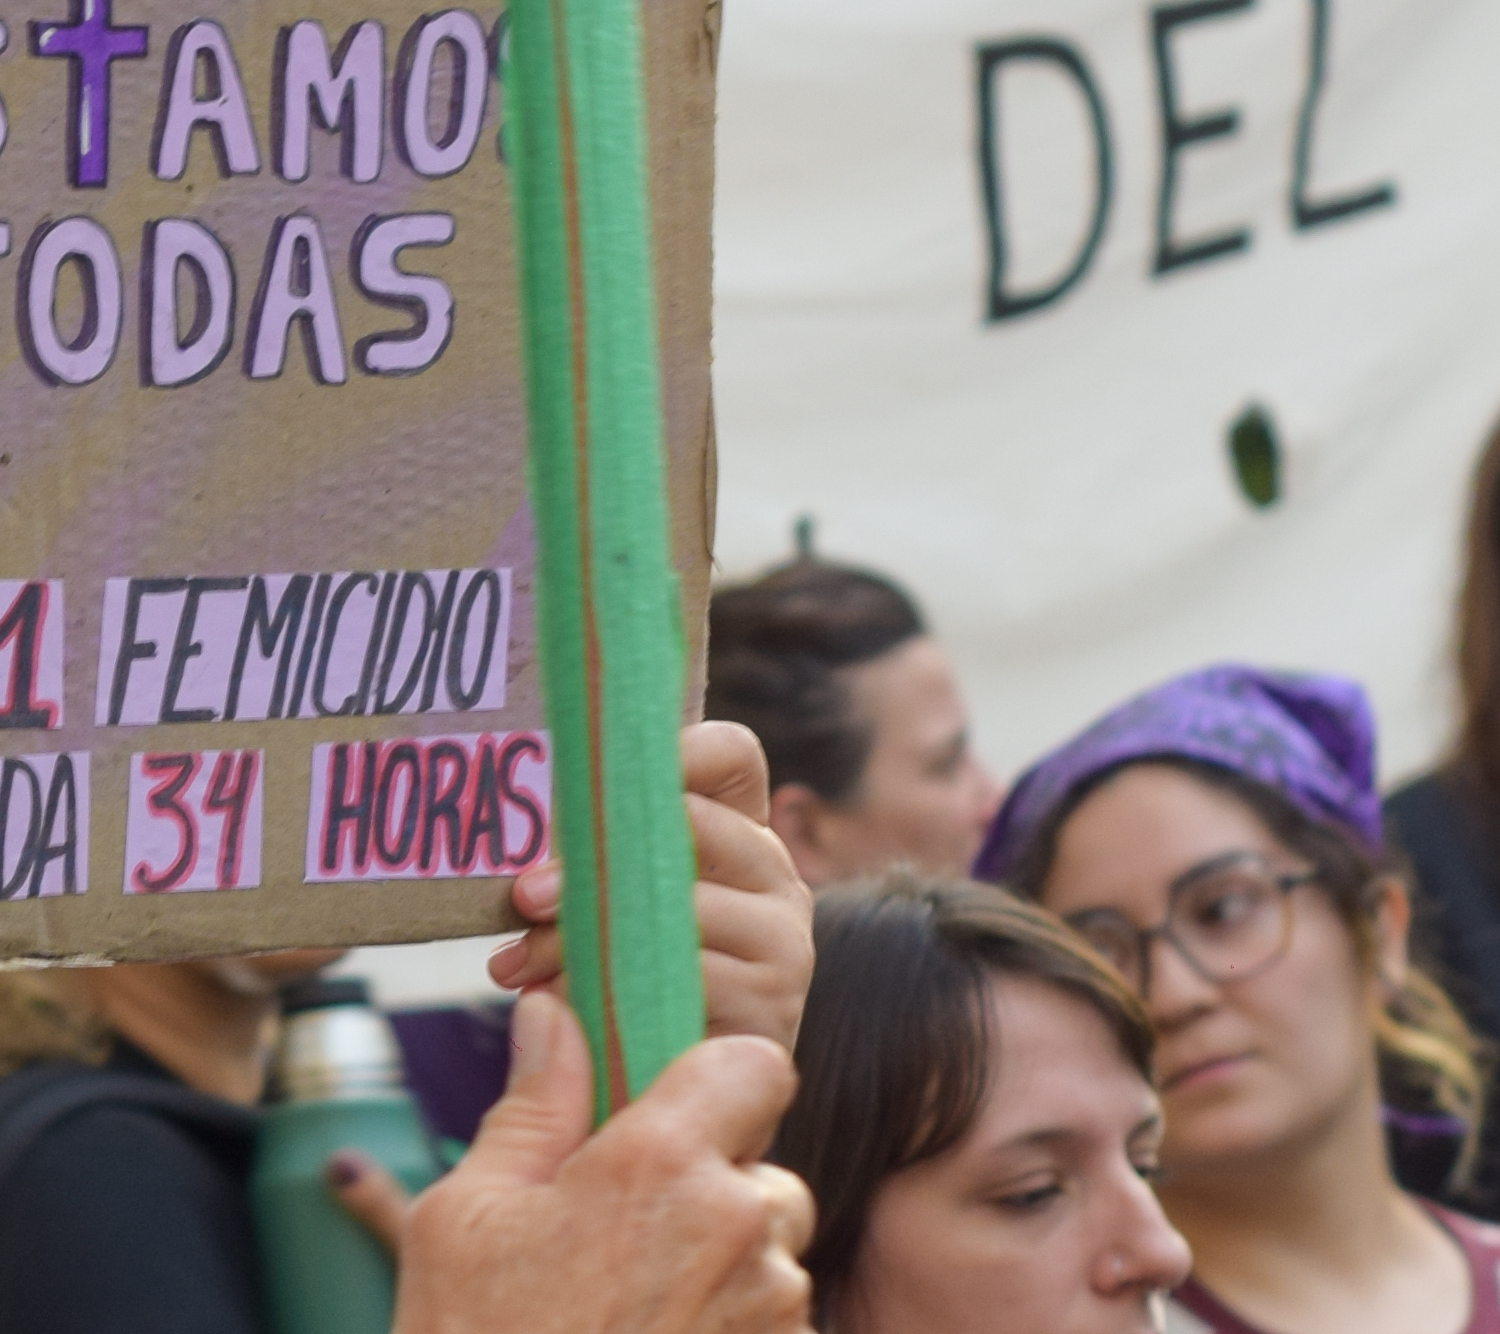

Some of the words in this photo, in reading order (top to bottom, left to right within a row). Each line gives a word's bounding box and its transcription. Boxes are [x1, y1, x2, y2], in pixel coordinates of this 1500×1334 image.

[108, 571, 501, 723] FEMICIDIO
[132, 750, 260, 892] 34
[320, 731, 550, 876] HORAS
